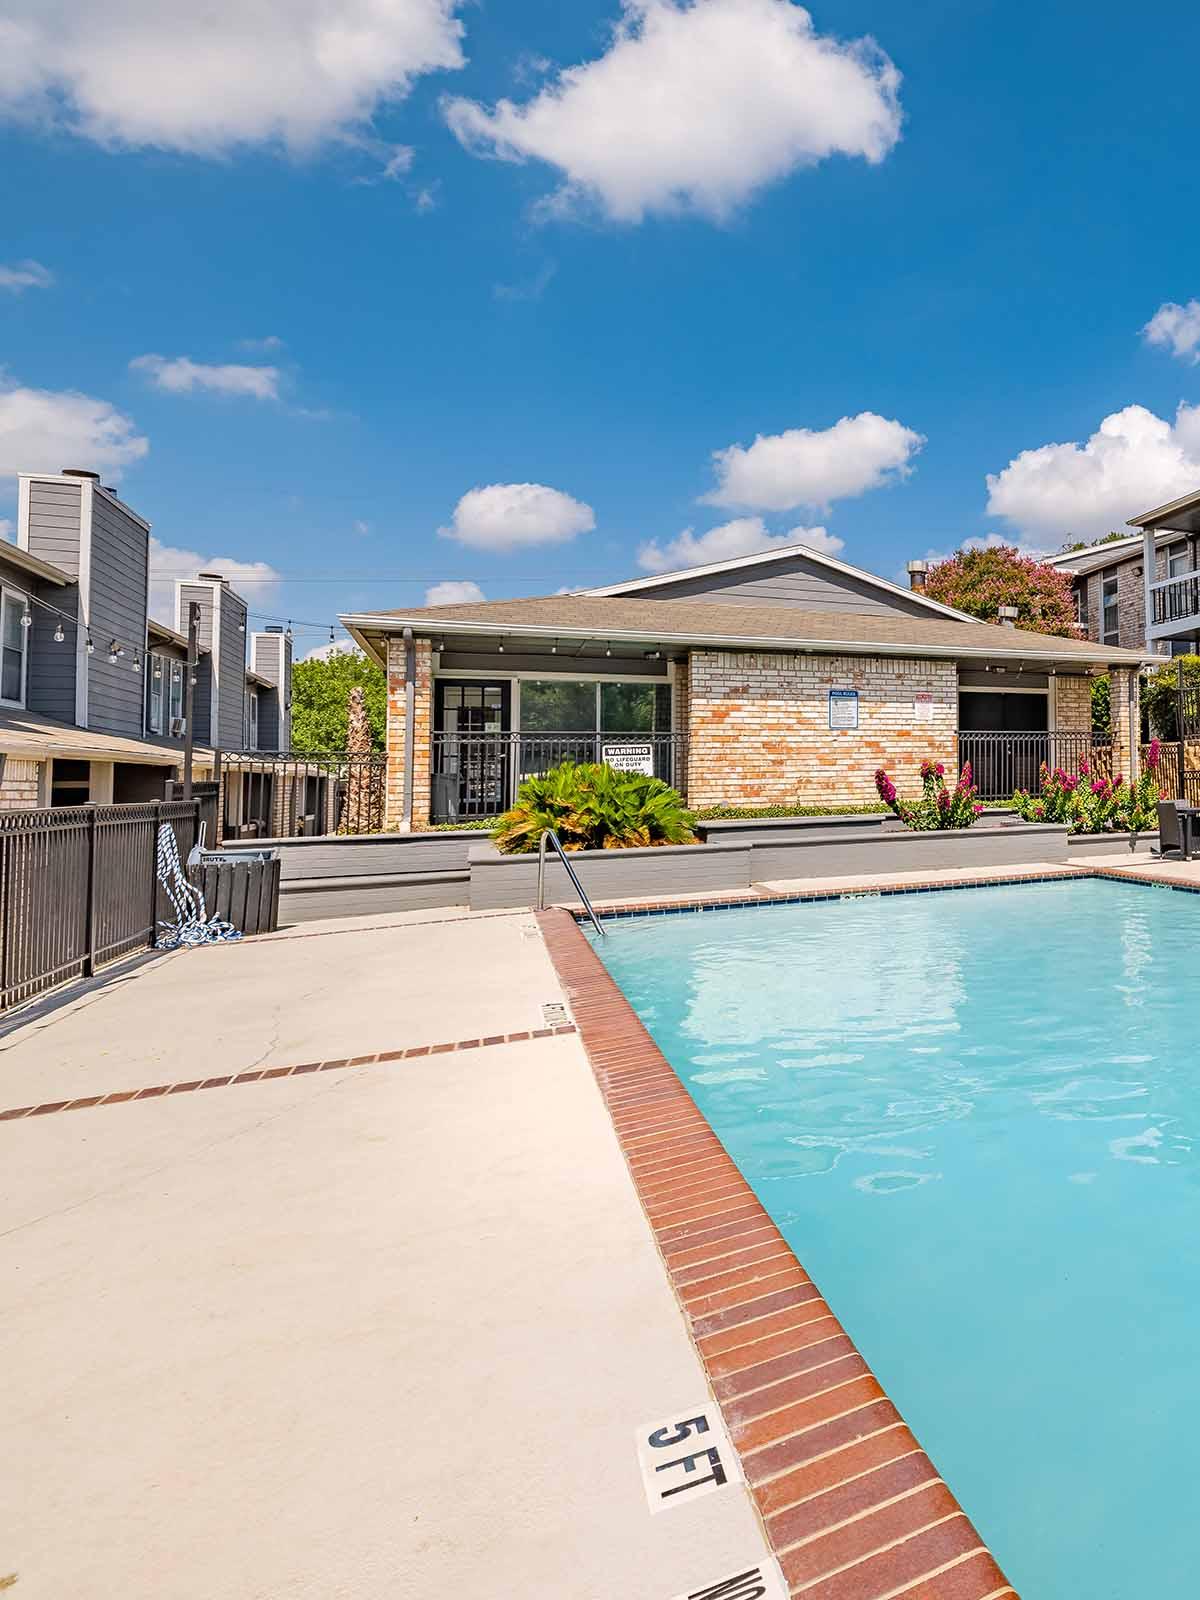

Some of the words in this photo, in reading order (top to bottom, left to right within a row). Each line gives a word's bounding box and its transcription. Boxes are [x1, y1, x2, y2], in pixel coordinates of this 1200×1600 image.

[607, 747, 648, 755] WARNING
[648, 1415, 711, 1449] 5
[656, 1446, 729, 1499] FT
